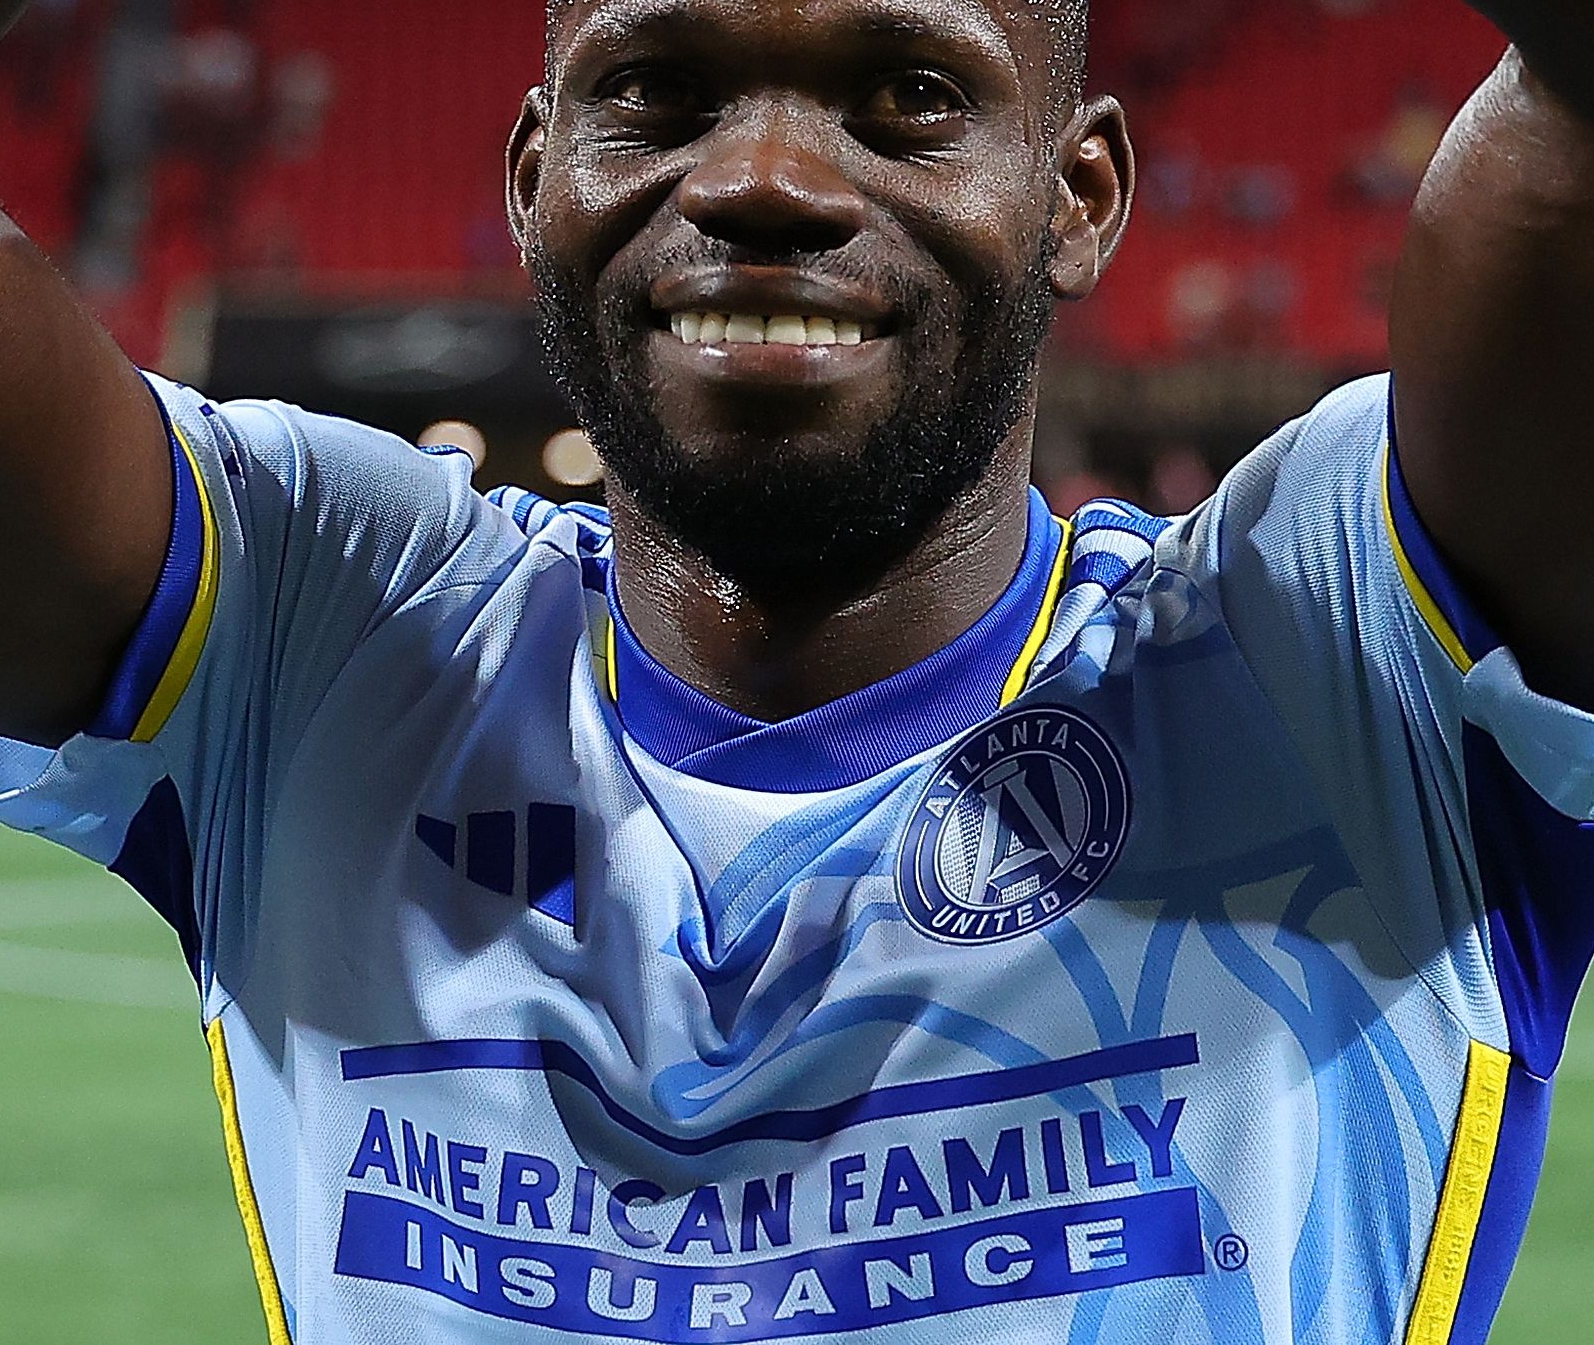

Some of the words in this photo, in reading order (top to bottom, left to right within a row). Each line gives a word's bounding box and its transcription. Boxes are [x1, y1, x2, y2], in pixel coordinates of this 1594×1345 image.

[924, 718, 1069, 820] ATLANTA
[931, 890, 1061, 936] UNITED
[1071, 840, 1110, 883] FC
[347, 1106, 794, 1255] AMERICAN
[828, 1096, 1188, 1234] FAMILY
[406, 1217, 1128, 1329] INSURANCE
